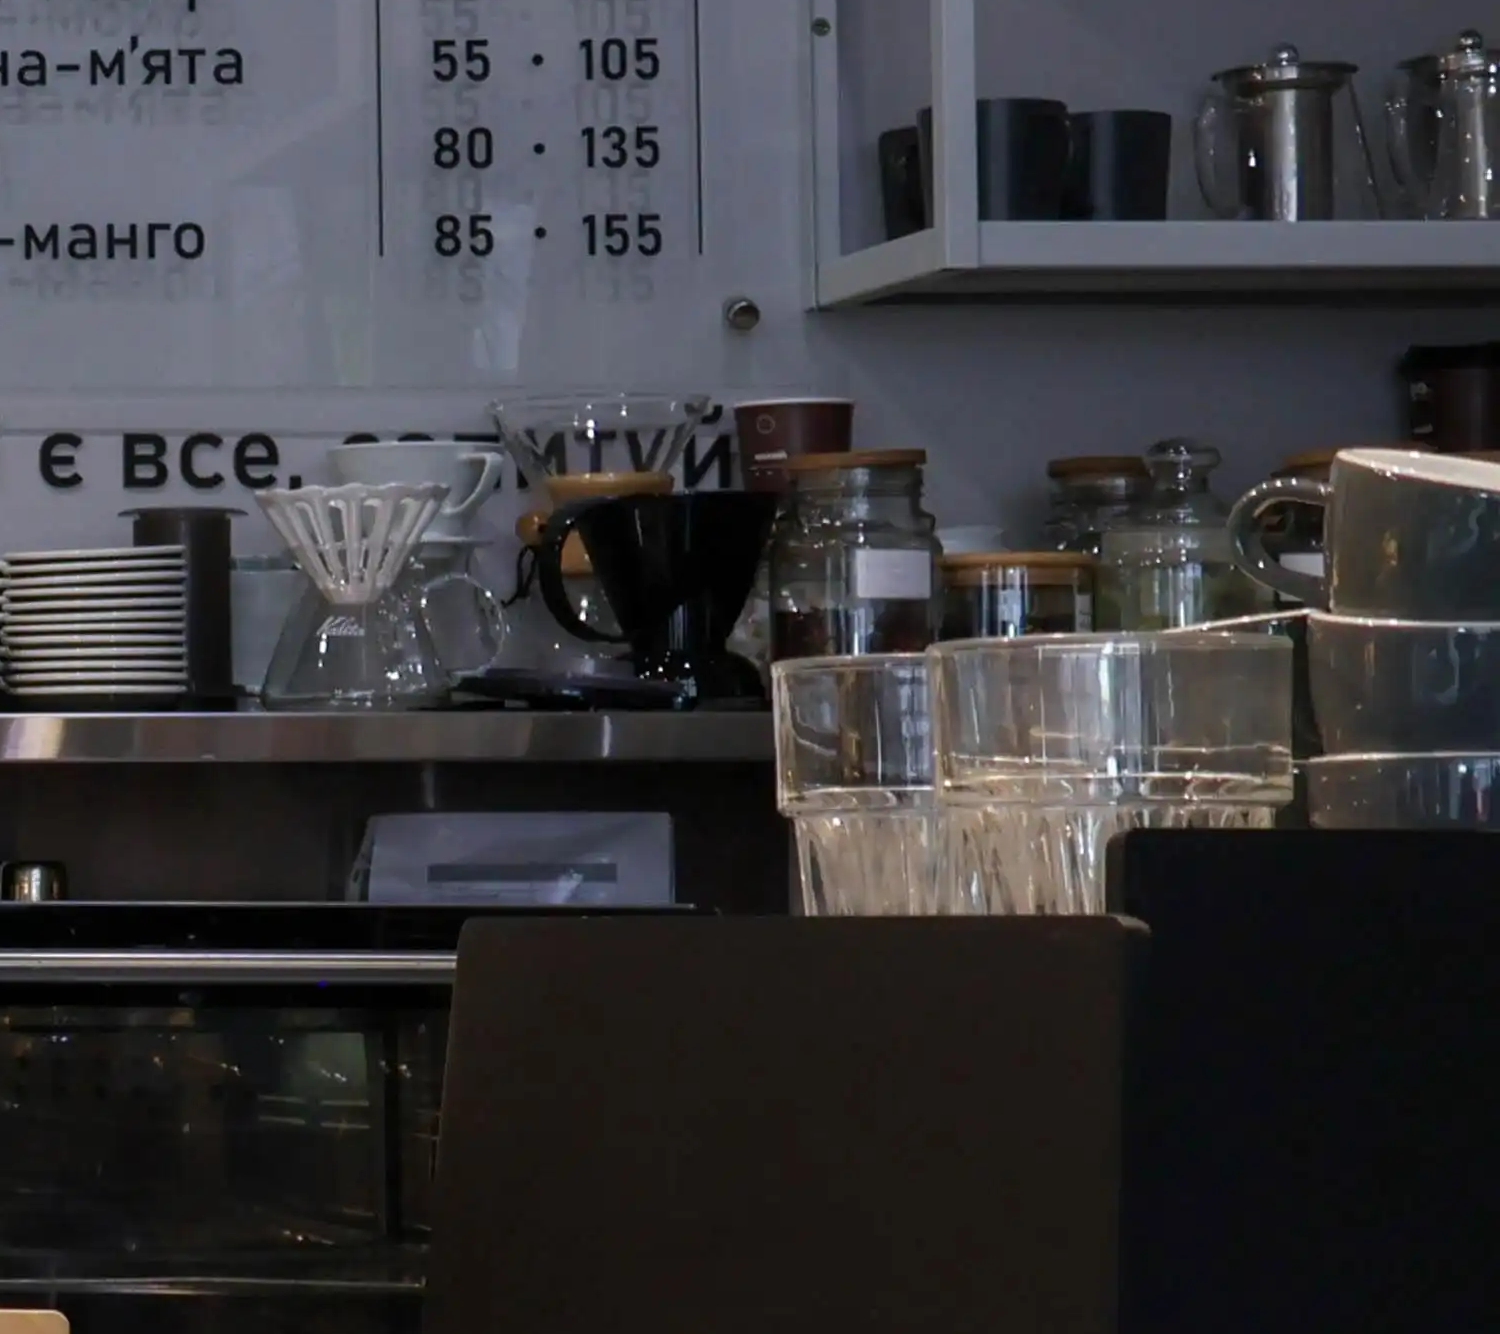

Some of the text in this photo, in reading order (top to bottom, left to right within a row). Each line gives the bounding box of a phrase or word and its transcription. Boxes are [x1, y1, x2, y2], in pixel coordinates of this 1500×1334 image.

[433, 38, 660, 82] 55 105
[434, 213, 662, 257] 85 155
[38, 432, 85, 490] є
